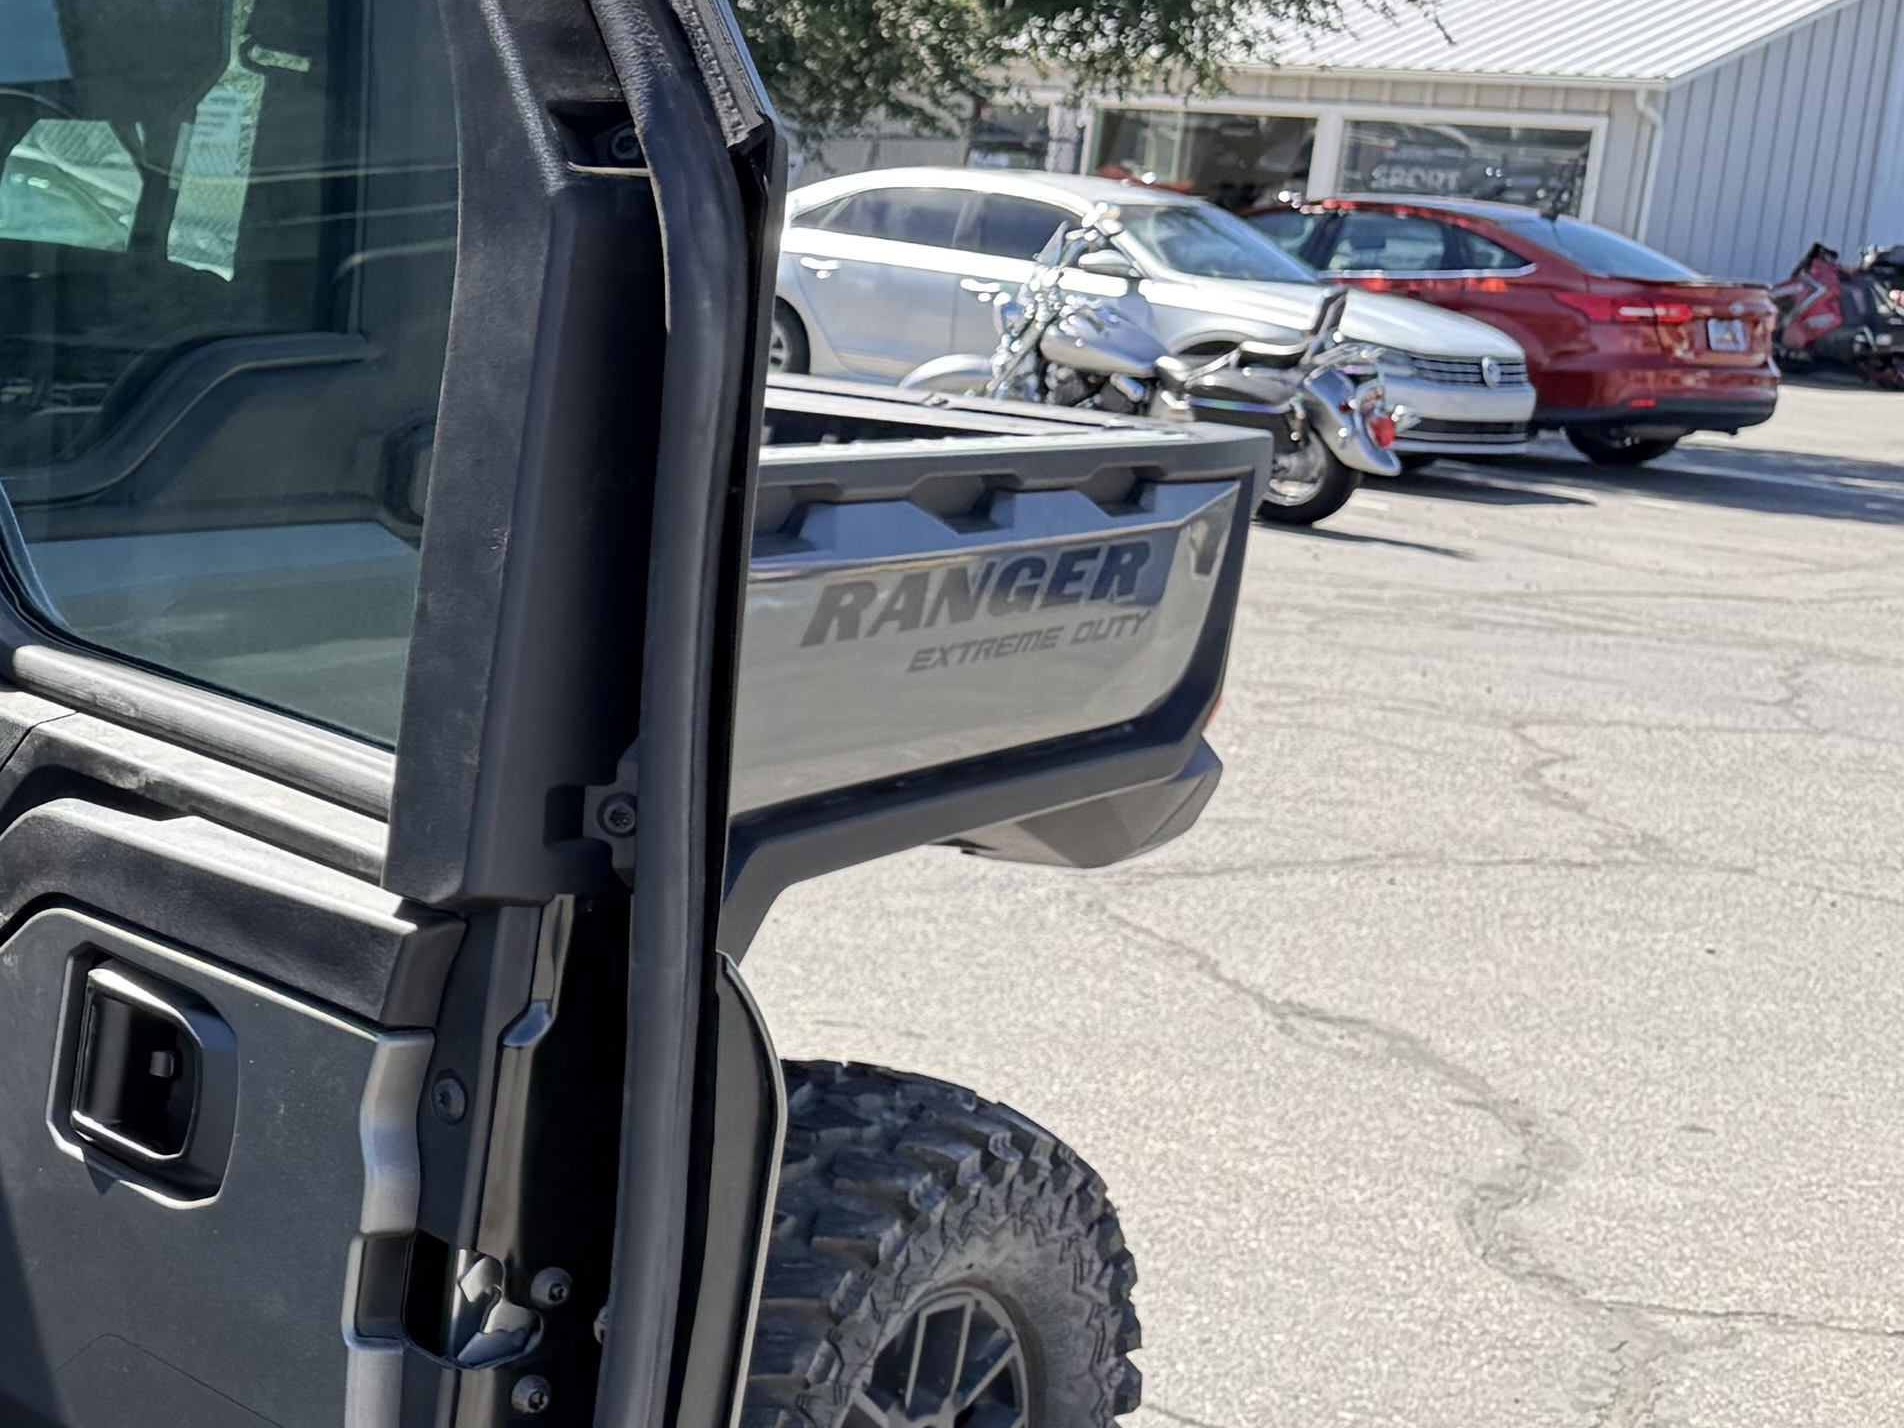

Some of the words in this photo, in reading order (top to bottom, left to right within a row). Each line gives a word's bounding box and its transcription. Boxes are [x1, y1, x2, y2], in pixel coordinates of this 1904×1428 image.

[1371, 164, 1461, 191] SPORT
[800, 540, 1150, 648] RANGER
[906, 625, 1058, 673] EXTREME
[1069, 609, 1152, 646] DUTY
